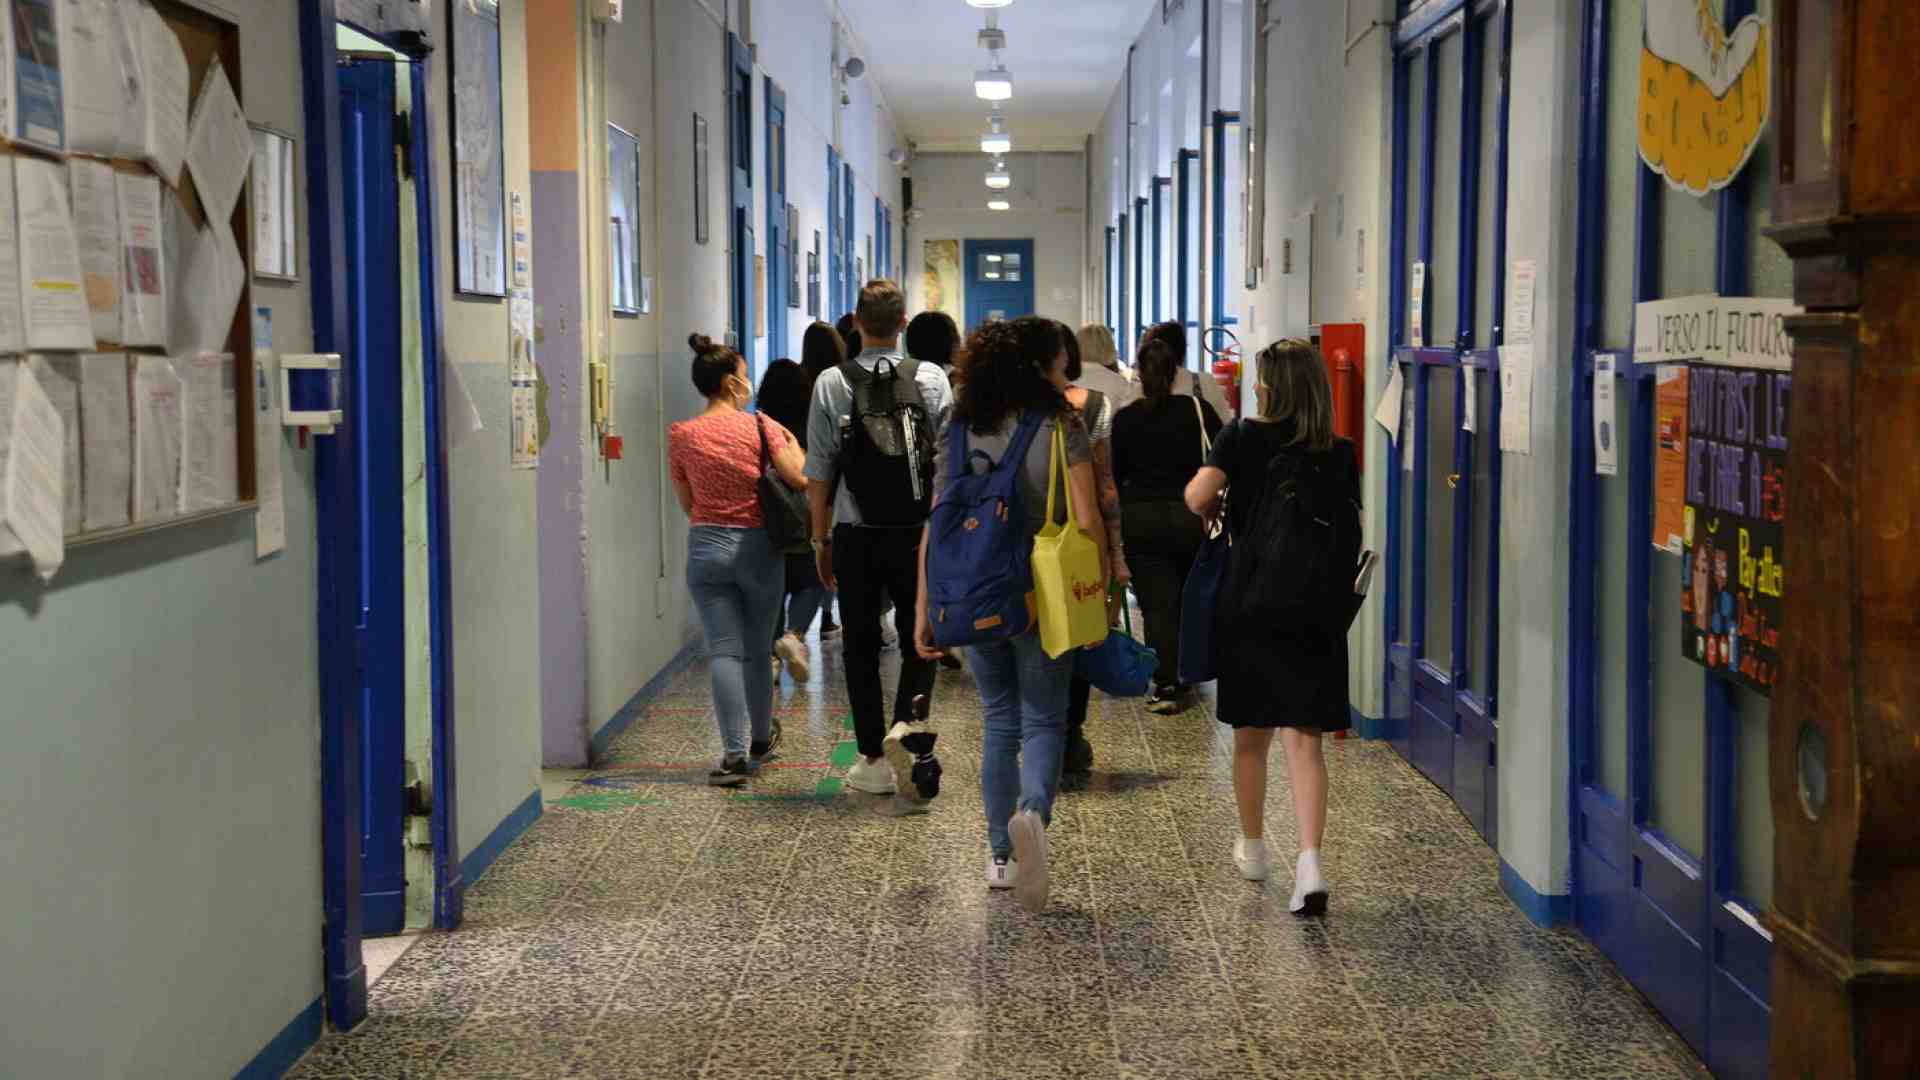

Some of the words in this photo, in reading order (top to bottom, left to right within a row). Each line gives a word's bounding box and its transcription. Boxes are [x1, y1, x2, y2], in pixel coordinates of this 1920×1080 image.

[1656, 313, 1700, 354] VERSO
[1705, 307, 1722, 351] IL
[1728, 311, 1793, 359] FUTUR
